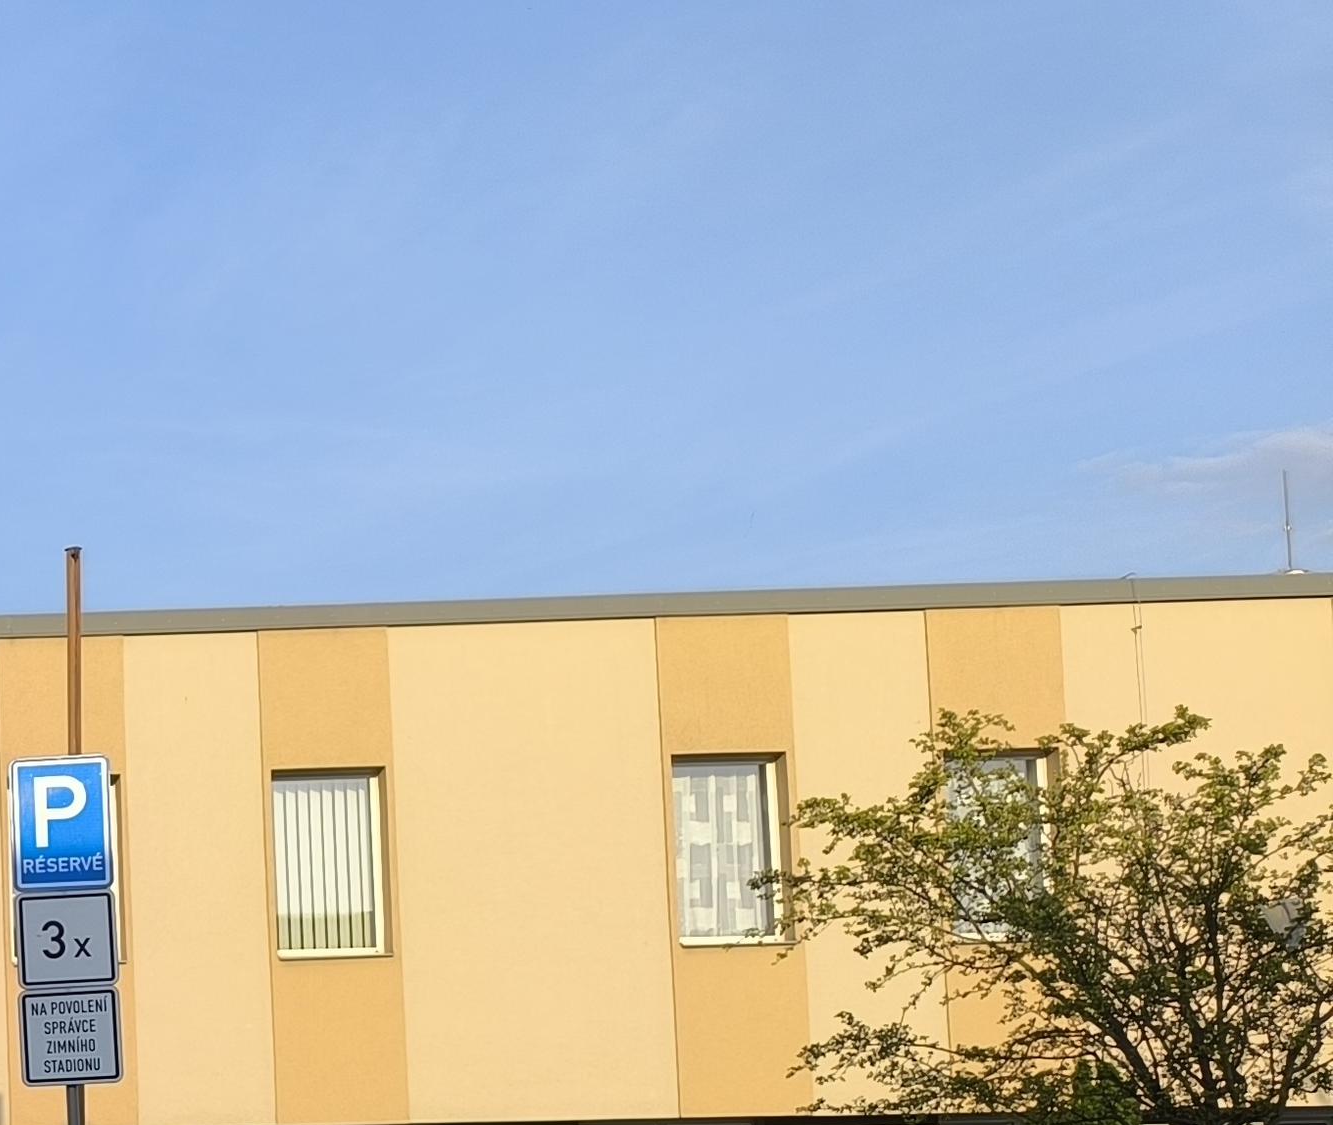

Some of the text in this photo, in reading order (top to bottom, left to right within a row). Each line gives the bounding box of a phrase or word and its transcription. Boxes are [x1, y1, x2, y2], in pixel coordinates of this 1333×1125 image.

[33, 774, 88, 848] P
[23, 852, 104, 874] RÉSERVÉ
[31, 996, 108, 1017] NA POVOLENÍ
[44, 1017, 96, 1035] SPRÁVCE
[46, 1036, 96, 1054] ZIMNÍHO
[44, 1058, 101, 1073] STADIONU
